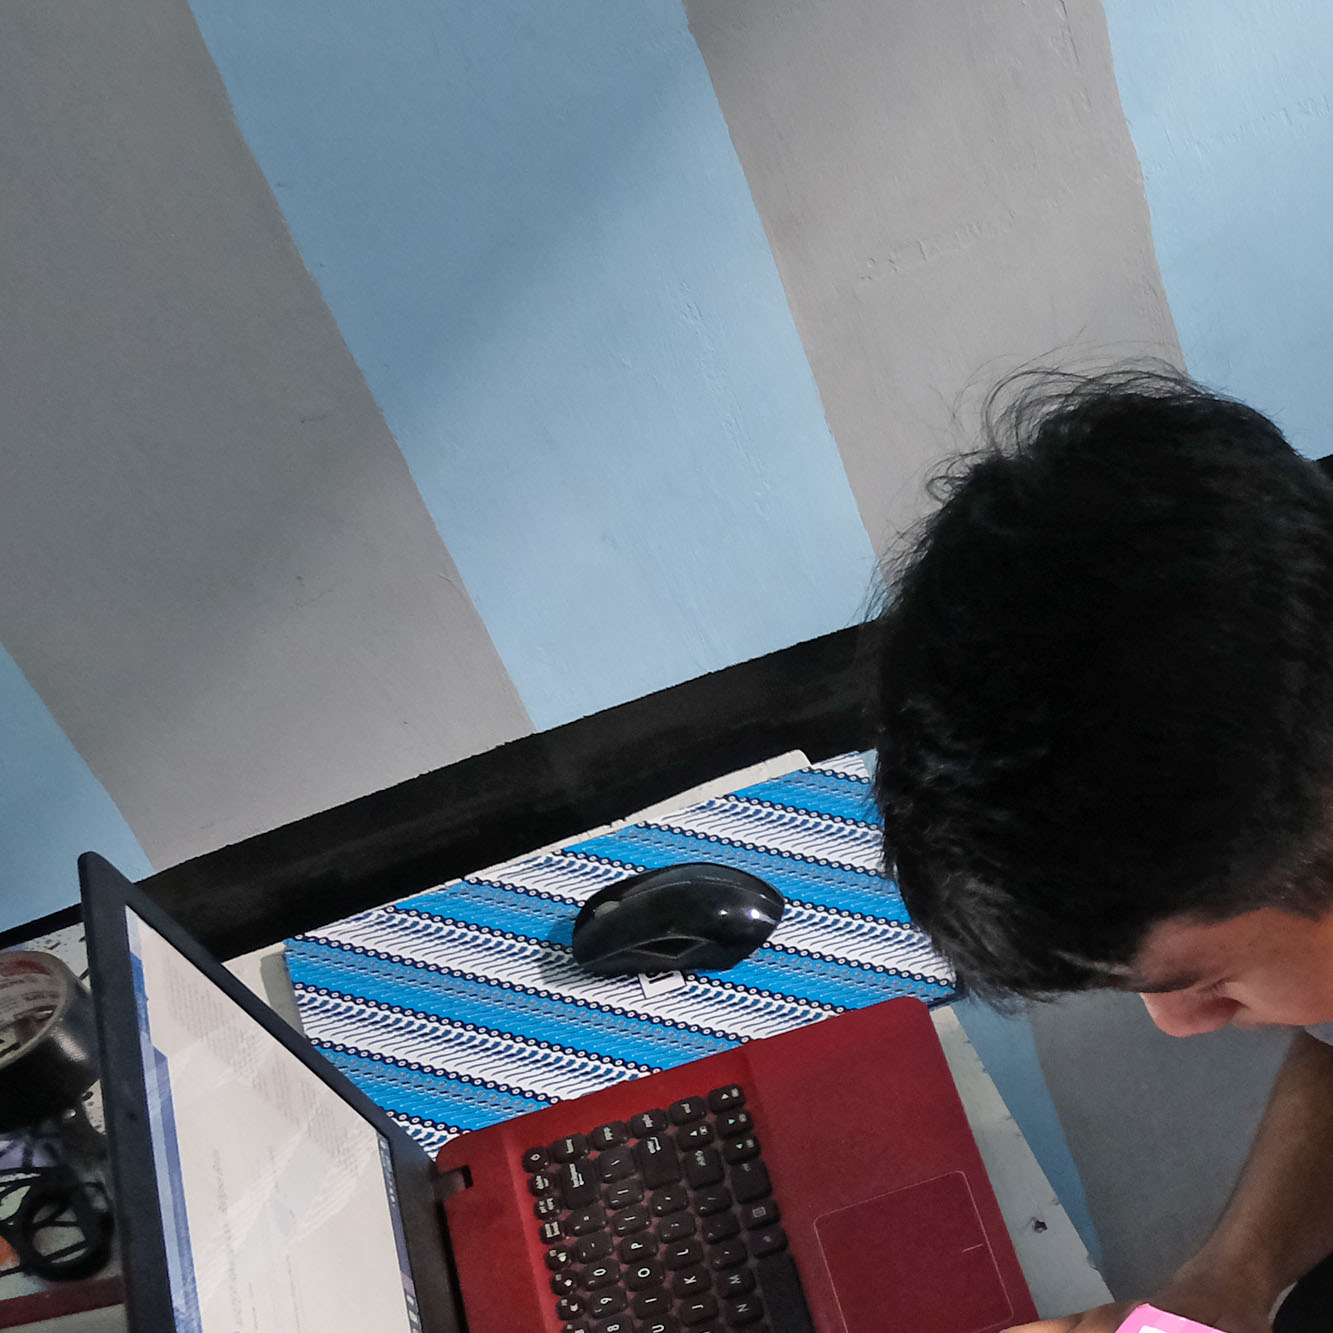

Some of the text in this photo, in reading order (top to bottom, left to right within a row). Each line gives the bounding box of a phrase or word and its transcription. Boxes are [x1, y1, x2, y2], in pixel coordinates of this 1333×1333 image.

[629, 1241, 643, 1250] P
[676, 1247, 689, 1256] L
[592, 1267, 607, 1276] 0
[636, 1266, 651, 1278] O
[682, 1274, 697, 1284] K
[728, 1273, 741, 1285] M
[599, 1296, 613, 1305] 9
[736, 1302, 748, 1313] N
[605, 1323, 620, 1333] 8
[650, 1323, 665, 1333] U
